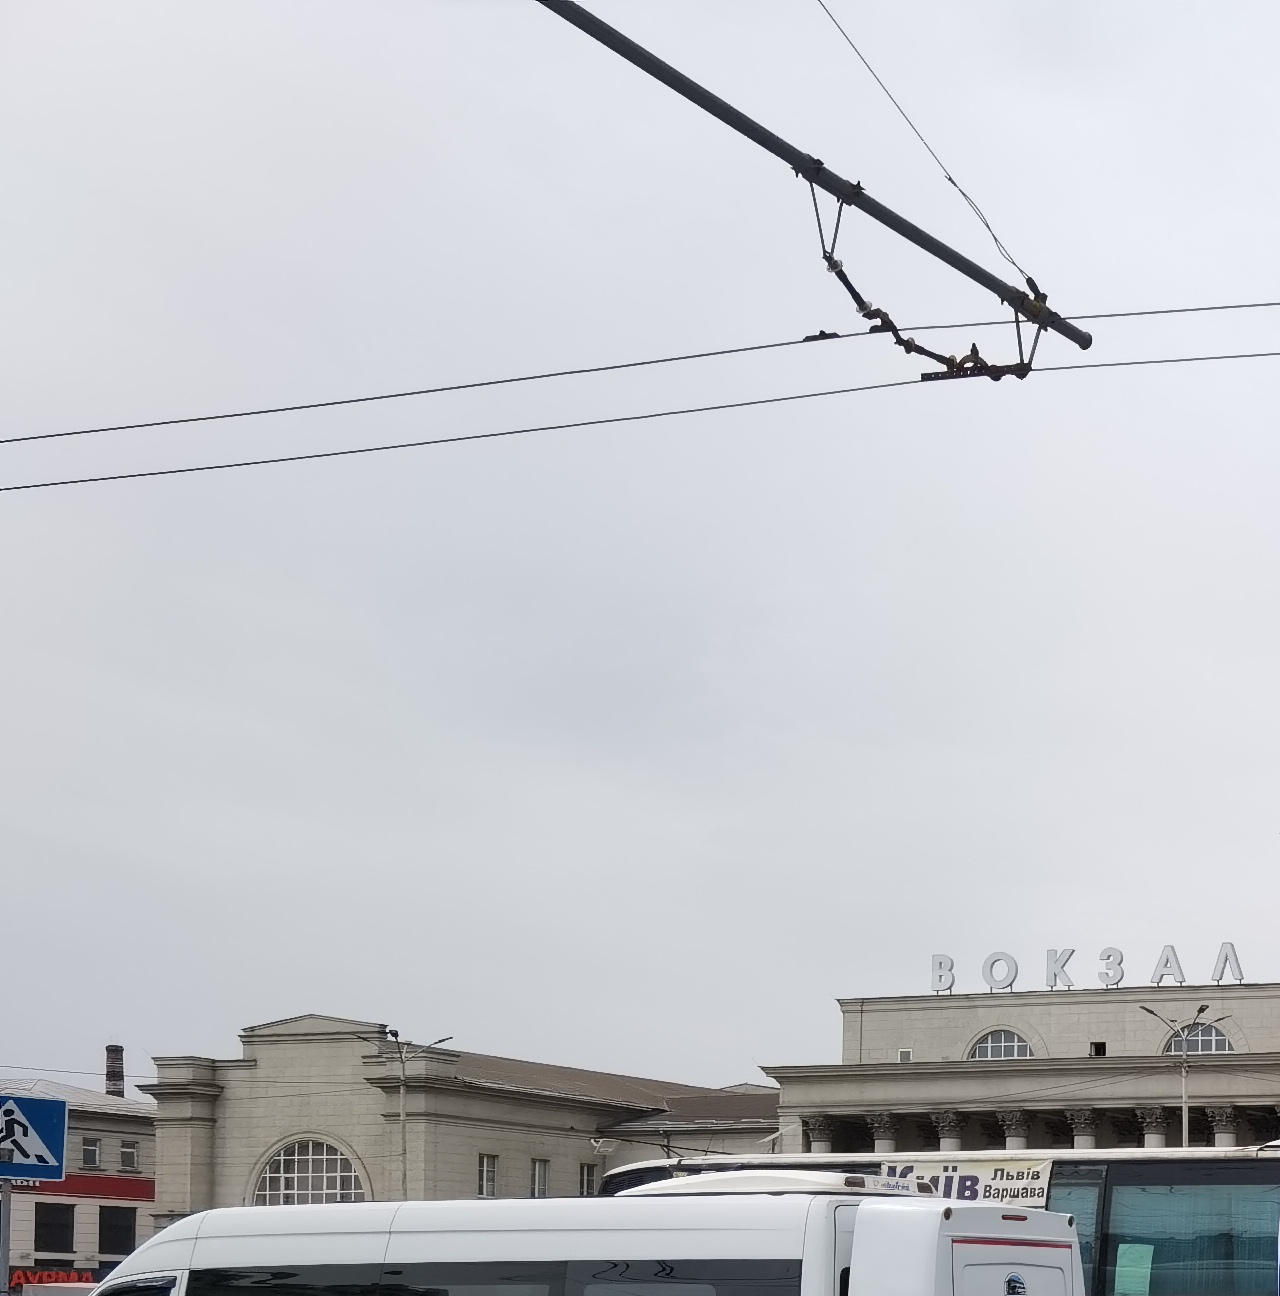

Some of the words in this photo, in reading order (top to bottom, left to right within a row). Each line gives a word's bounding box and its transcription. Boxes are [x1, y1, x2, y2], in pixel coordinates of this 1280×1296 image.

[931, 942, 1245, 991] ВОКЗАЛ
[991, 1168, 1041, 1181] Львів
[983, 1184, 1045, 1203] Варшава
